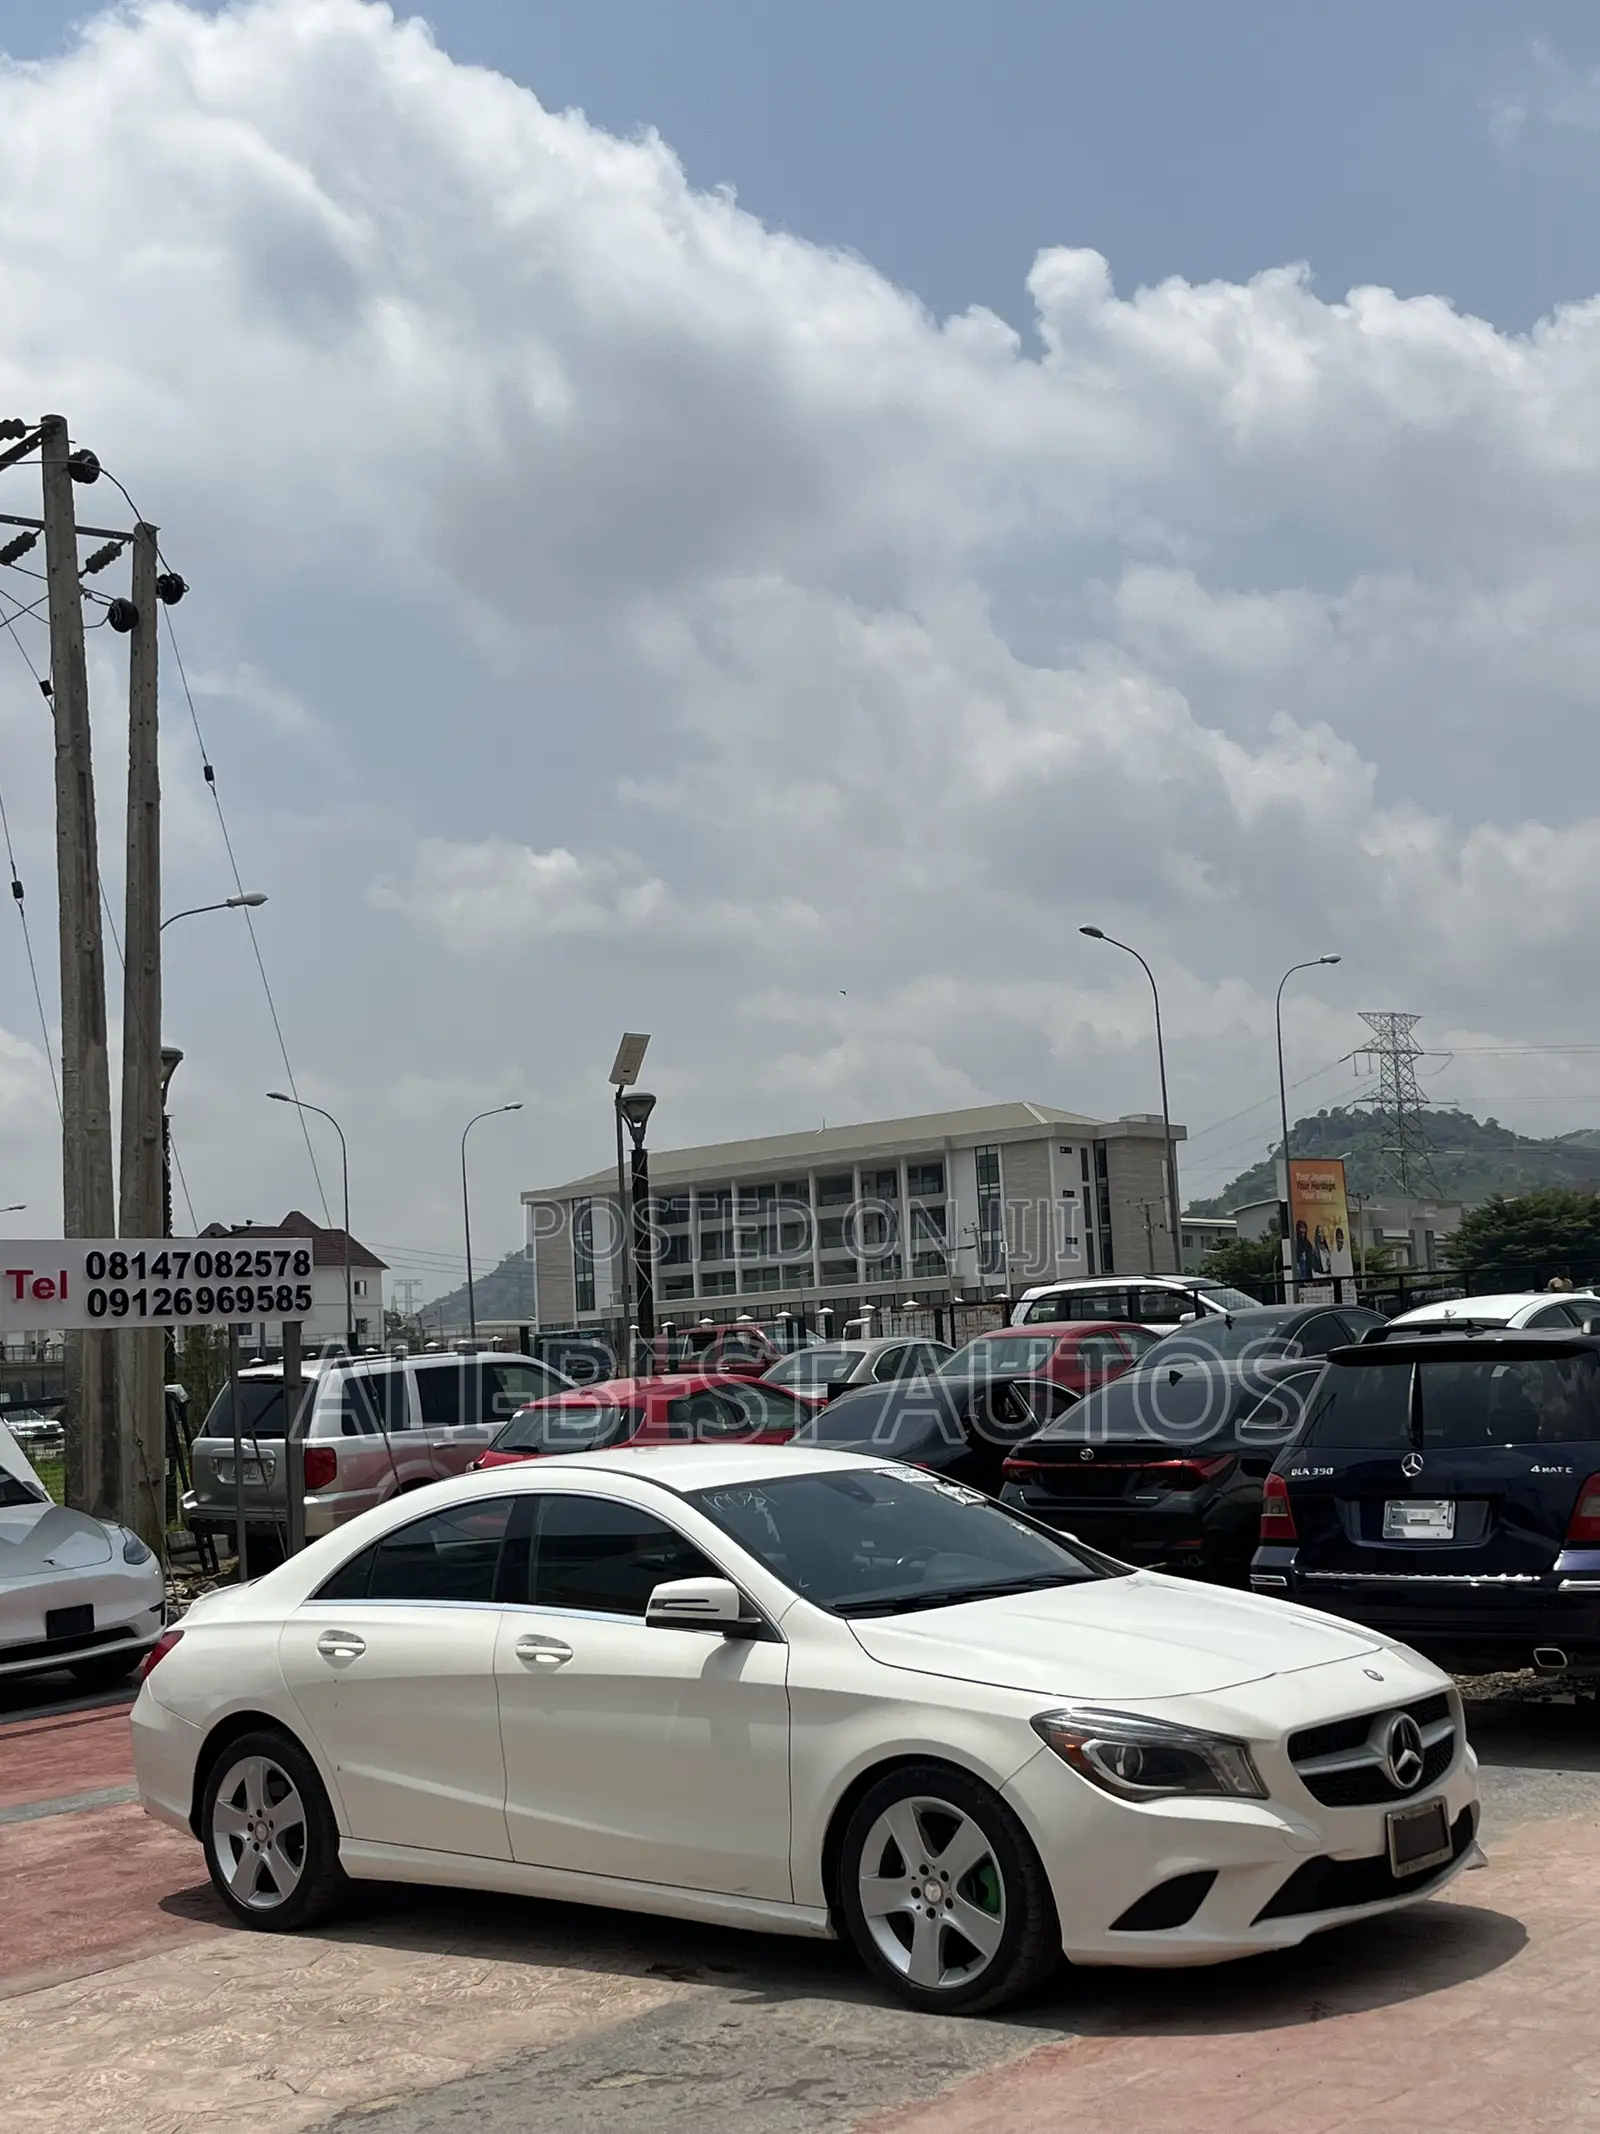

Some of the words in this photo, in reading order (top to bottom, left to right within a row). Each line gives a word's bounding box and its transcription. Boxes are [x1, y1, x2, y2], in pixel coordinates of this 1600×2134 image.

[85, 1249, 311, 1280] 08147082578
[5, 1269, 68, 1301] Tel
[87, 1284, 313, 1317] 09126969585
